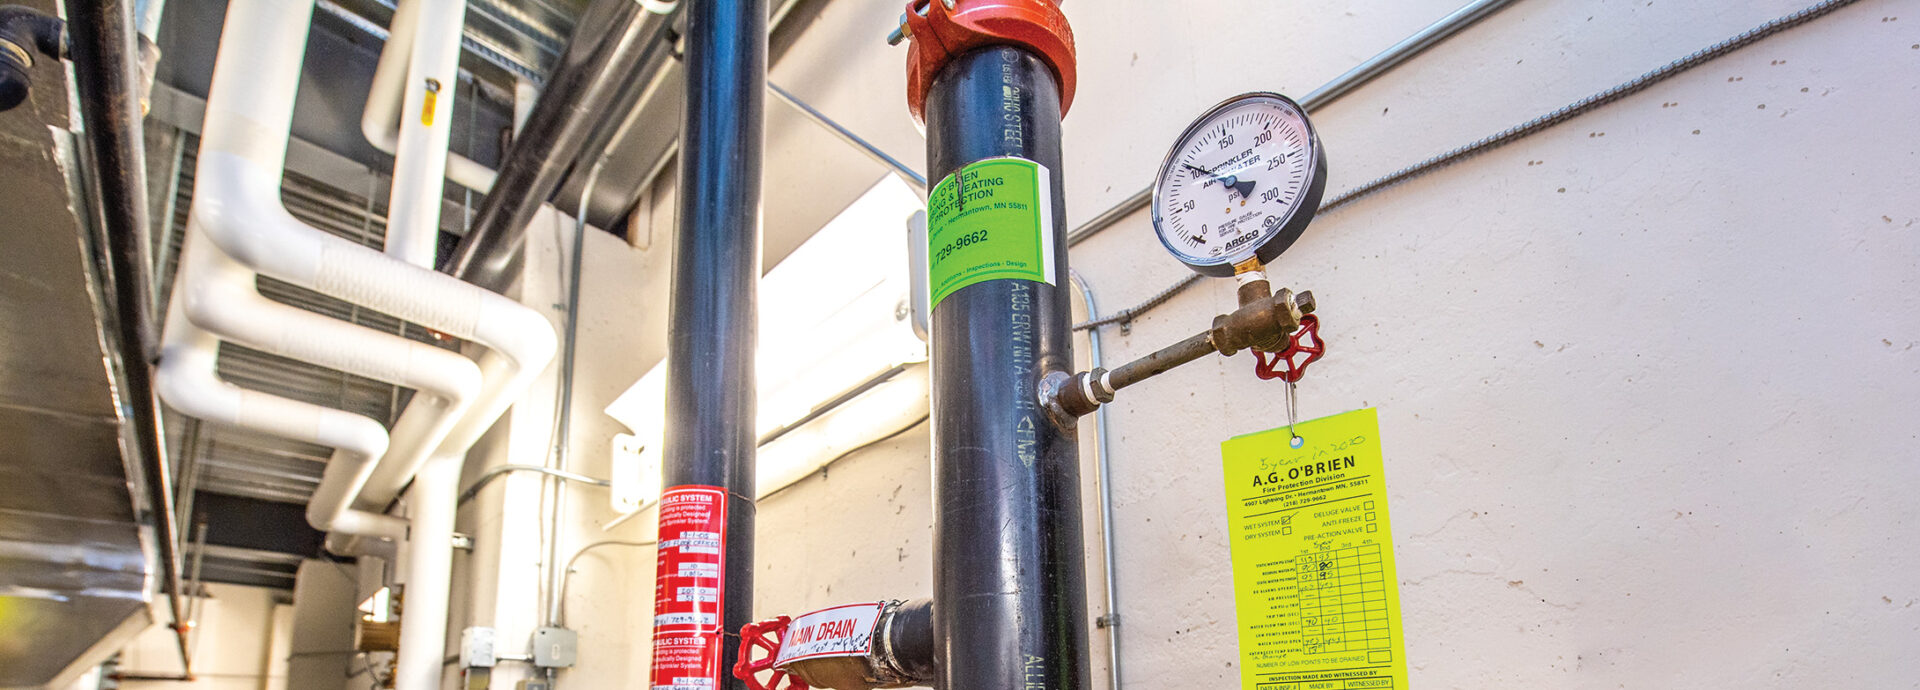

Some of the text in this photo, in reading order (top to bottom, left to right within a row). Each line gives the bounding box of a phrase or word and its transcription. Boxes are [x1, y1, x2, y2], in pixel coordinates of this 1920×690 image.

[1217, 134, 1235, 150] 150
[1253, 130, 1272, 148] 200
[1266, 153, 1286, 172] 250
[1190, 165, 1205, 180] 100
[940, 170, 979, 197] O'BEN
[962, 177, 1004, 193] EATING
[1261, 186, 1279, 204] 300
[934, 188, 994, 225] PROTECTION
[994, 202, 1007, 210] MN
[1008, 202, 1028, 211] 55811
[1183, 200, 1195, 213] 50
[1201, 224, 1208, 235] 0
[935, 229, 988, 266] 729-9662
[1224, 229, 1260, 251] ARGCO
[966, 261, 1001, 274] Inspections
[1006, 260, 1027, 268] Design
[1252, 455, 1356, 487] A.G. O'BRIEN
[1262, 472, 1346, 494] Fire Protection Division
[680, 494, 712, 502] SYSTEM
[1259, 495, 1285, 506] Lightning
[1297, 485, 1334, 497] Hermantown
[1349, 479, 1369, 487] 55811
[1313, 504, 1361, 519] DELUGE VALVE
[1244, 519, 1281, 531] WET SYSTEM
[1244, 529, 1281, 541] DRY SYSTEM
[1303, 526, 1364, 541] PRE-ACTION VALVE
[788, 617, 858, 648] MAIN DRAIN
[673, 637, 706, 645] SYSTEM
[1338, 655, 1365, 663] DRAINED
[1268, 674, 1301, 682] INSPECTION
[1347, 680, 1379, 688] WITNESSED
[1309, 682, 1325, 690] MADE
